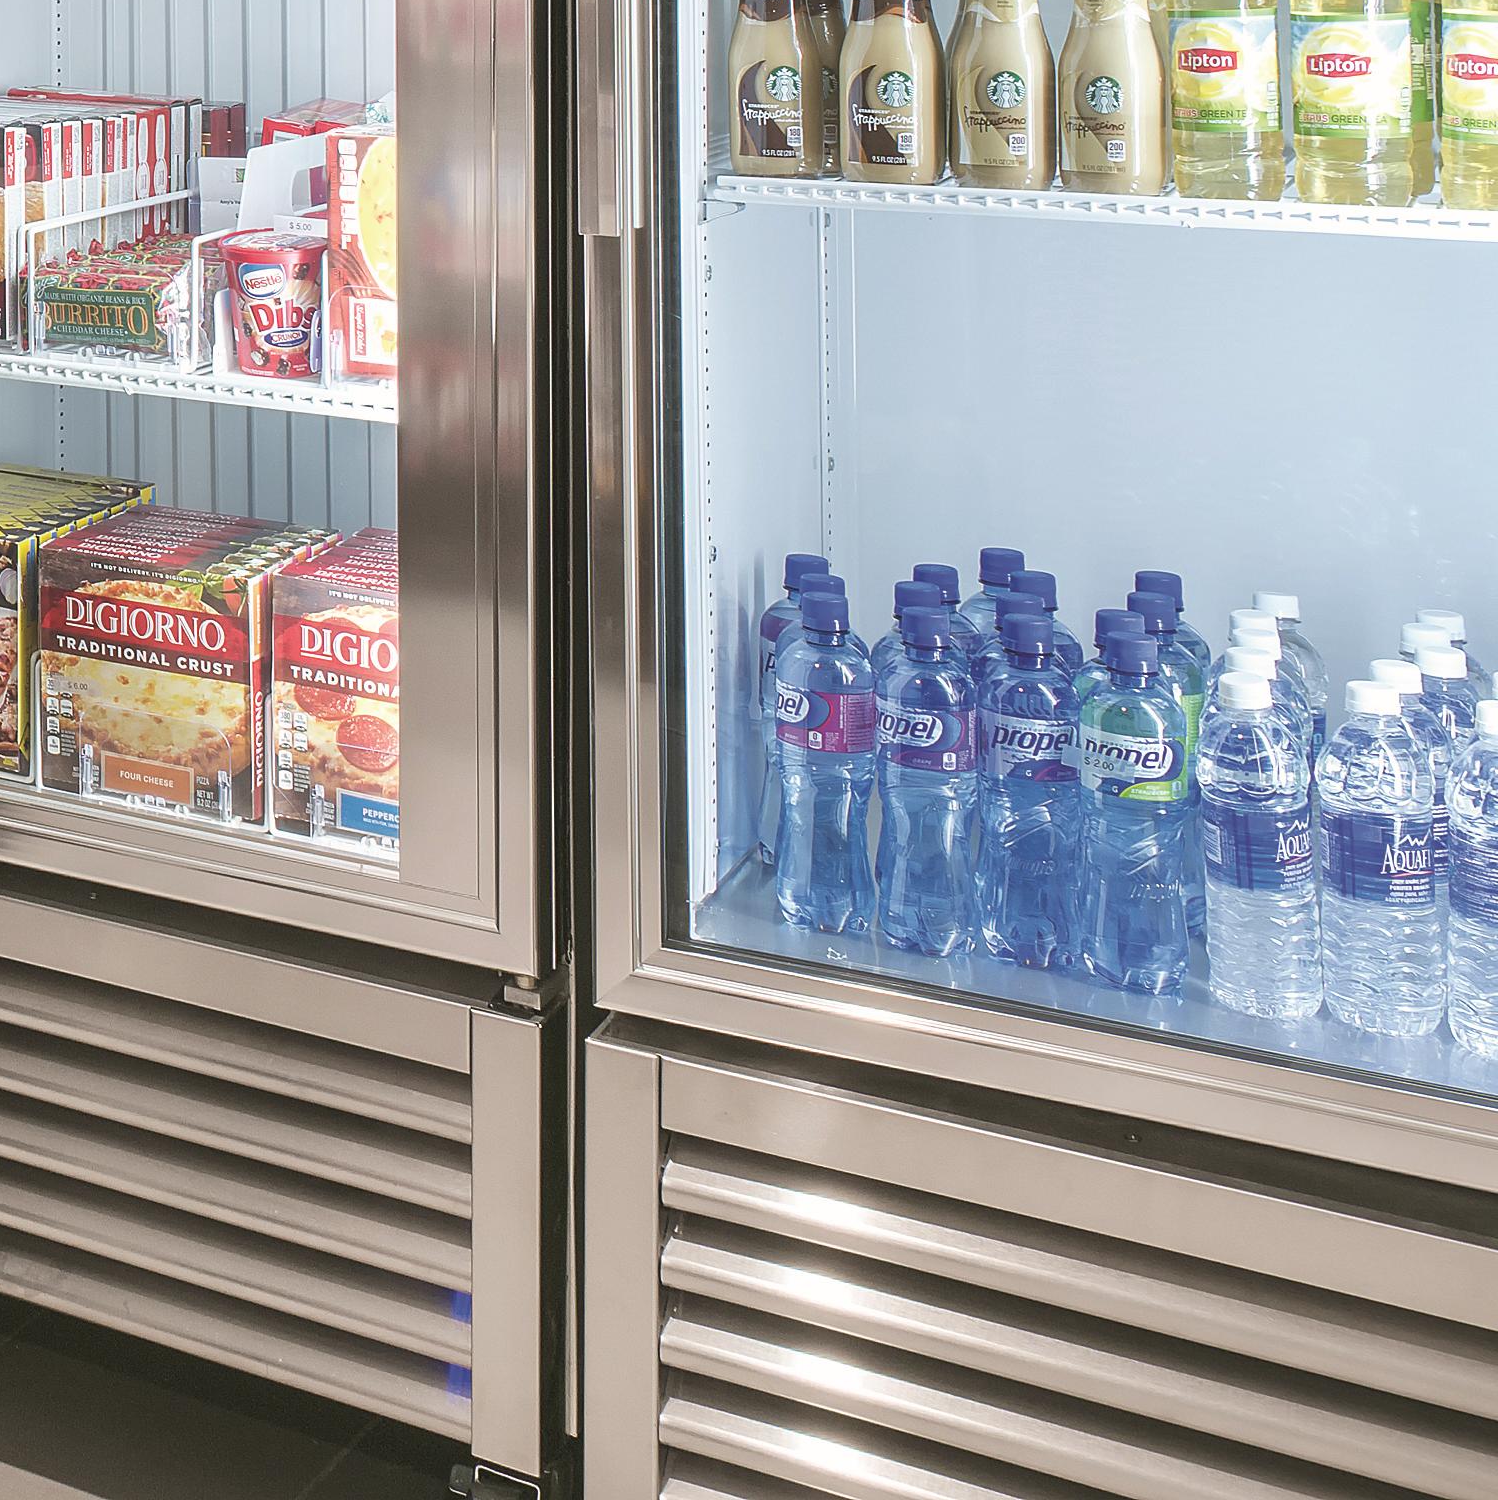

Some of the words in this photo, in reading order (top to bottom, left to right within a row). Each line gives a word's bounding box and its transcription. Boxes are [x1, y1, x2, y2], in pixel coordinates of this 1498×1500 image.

[1180, 51, 1233, 70] Lipton
[1310, 57, 1368, 76] Lipton
[1448, 58, 1498, 78] Lipton
[964, 106, 1026, 132] frappuccino
[1200, 110, 1233, 118] GREEN
[1064, 112, 1125, 138] frappuccino
[1109, 143, 1124, 151] 200
[57, 324, 95, 335] CHEDDAR
[95, 327, 125, 336] CHEESE
[271, 331, 303, 344] CRUNCH
[56, 634, 170, 667] TRADITIONAL
[176, 656, 234, 677] CRUST
[119, 770, 142, 783] FOUR
[143, 774, 174, 788] CHEESE
